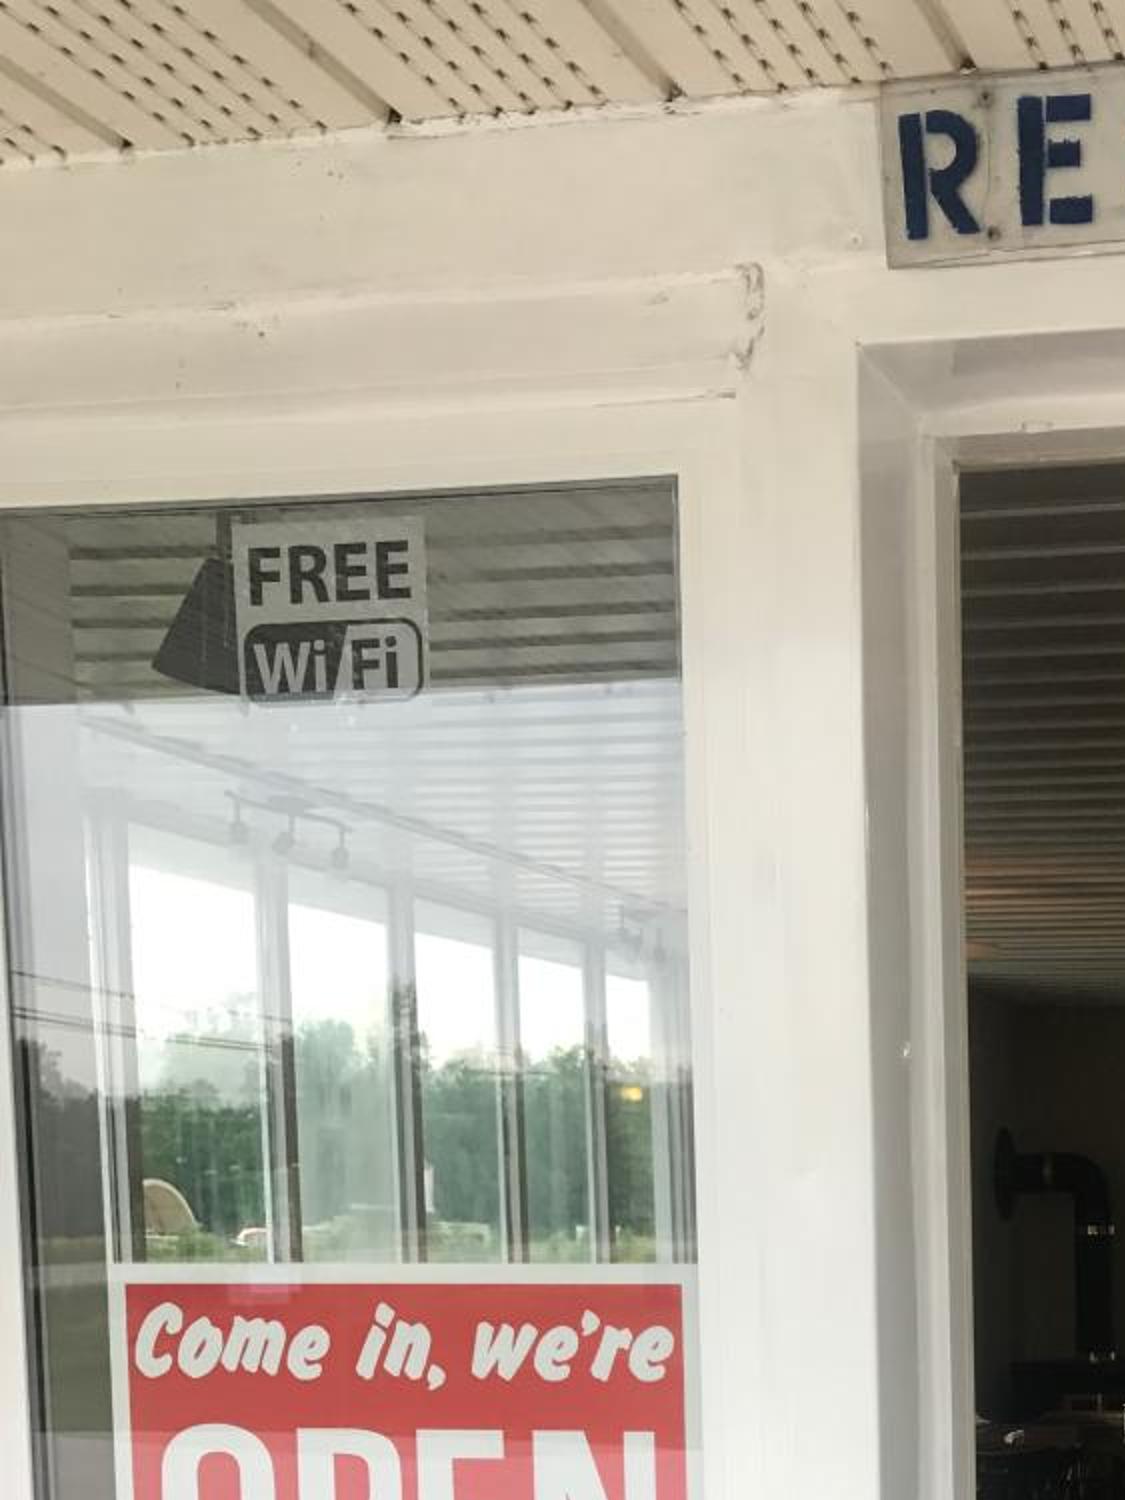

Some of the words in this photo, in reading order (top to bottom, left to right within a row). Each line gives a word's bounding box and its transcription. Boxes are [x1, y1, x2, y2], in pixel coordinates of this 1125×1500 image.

[247, 539, 413, 607] FREE
[134, 1301, 331, 1381] Come
[355, 1301, 446, 1391] in,
[470, 1309, 675, 1383] we're
